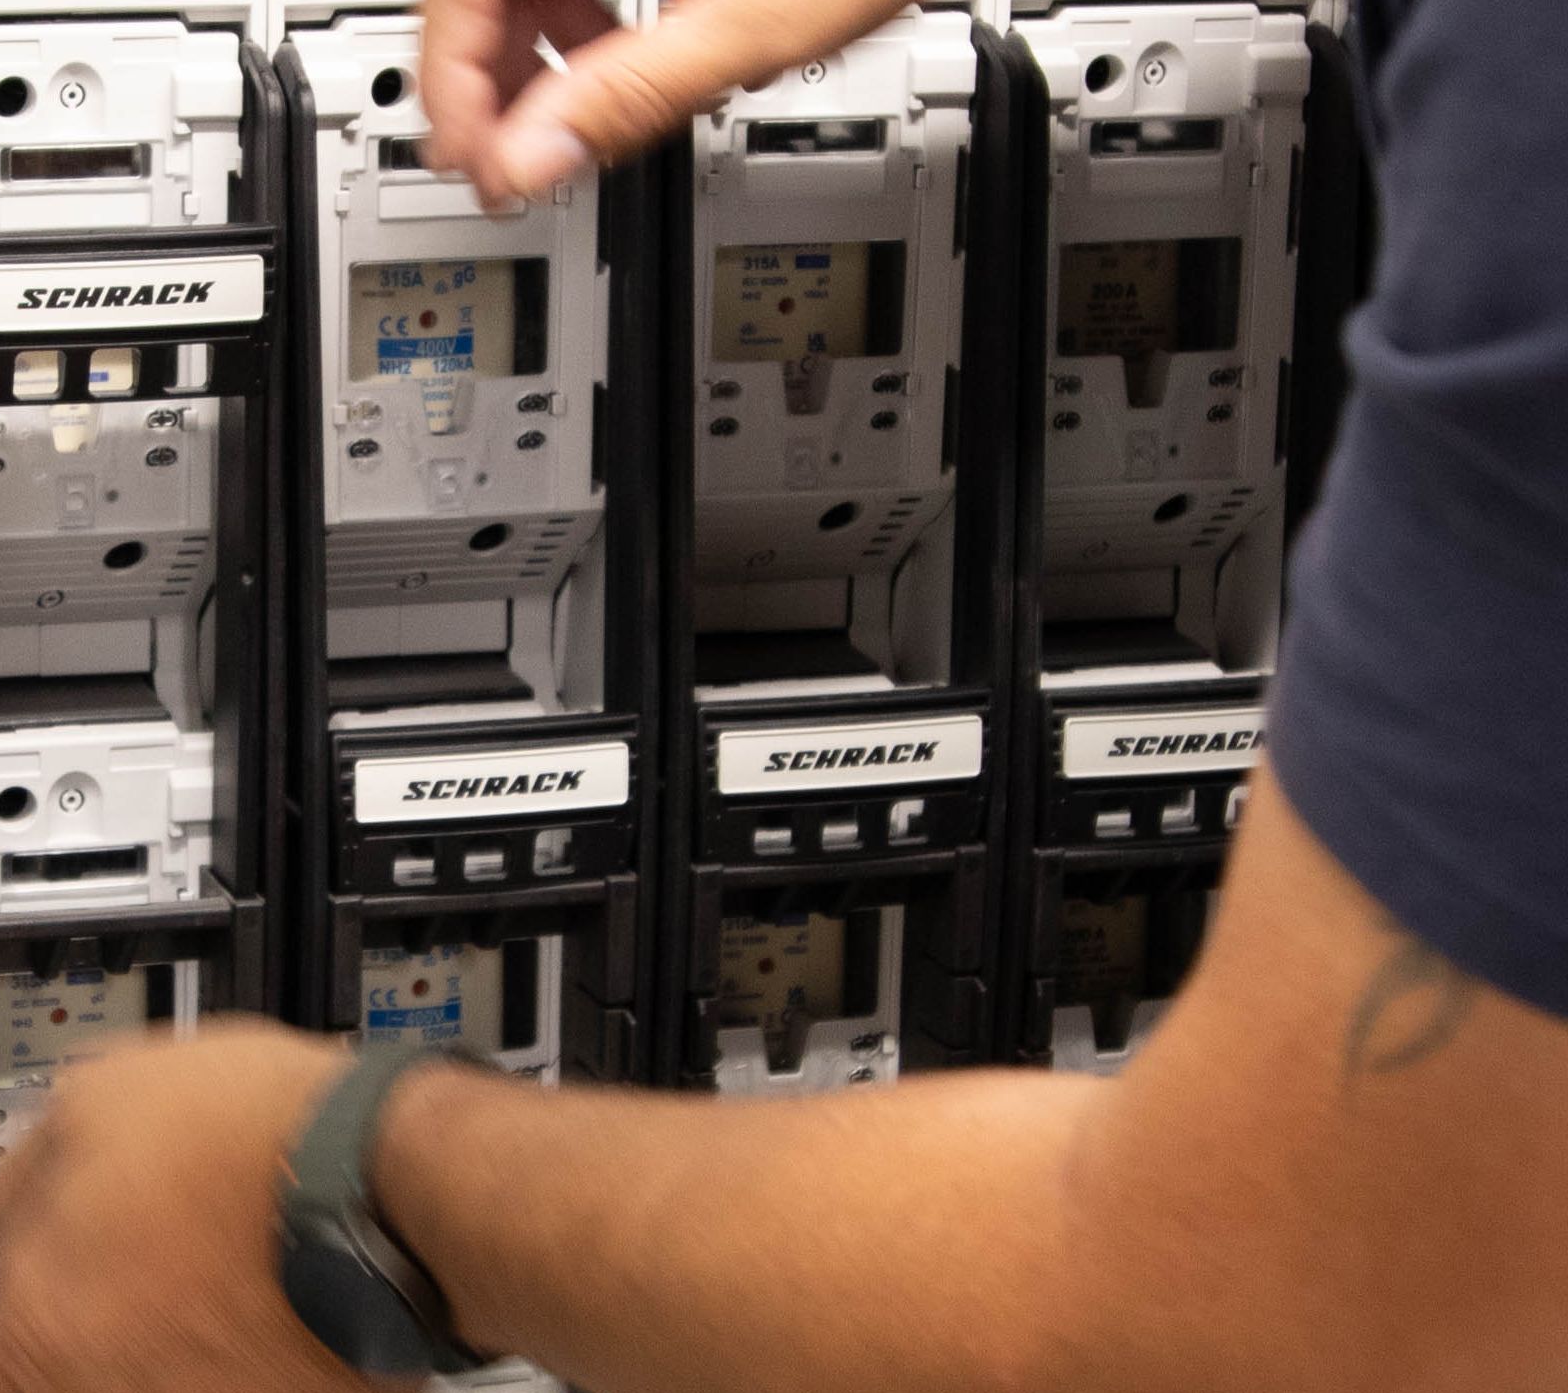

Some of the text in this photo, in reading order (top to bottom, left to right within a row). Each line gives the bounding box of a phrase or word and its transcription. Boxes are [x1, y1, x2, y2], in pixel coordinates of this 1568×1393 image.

[380, 269, 425, 287] 315A
[17, 281, 216, 309] SCHRACK
[378, 359, 412, 374] NH2
[433, 356, 474, 374] 120kA
[763, 741, 941, 772] SCHRACK
[402, 770, 586, 801] SCHRACK
